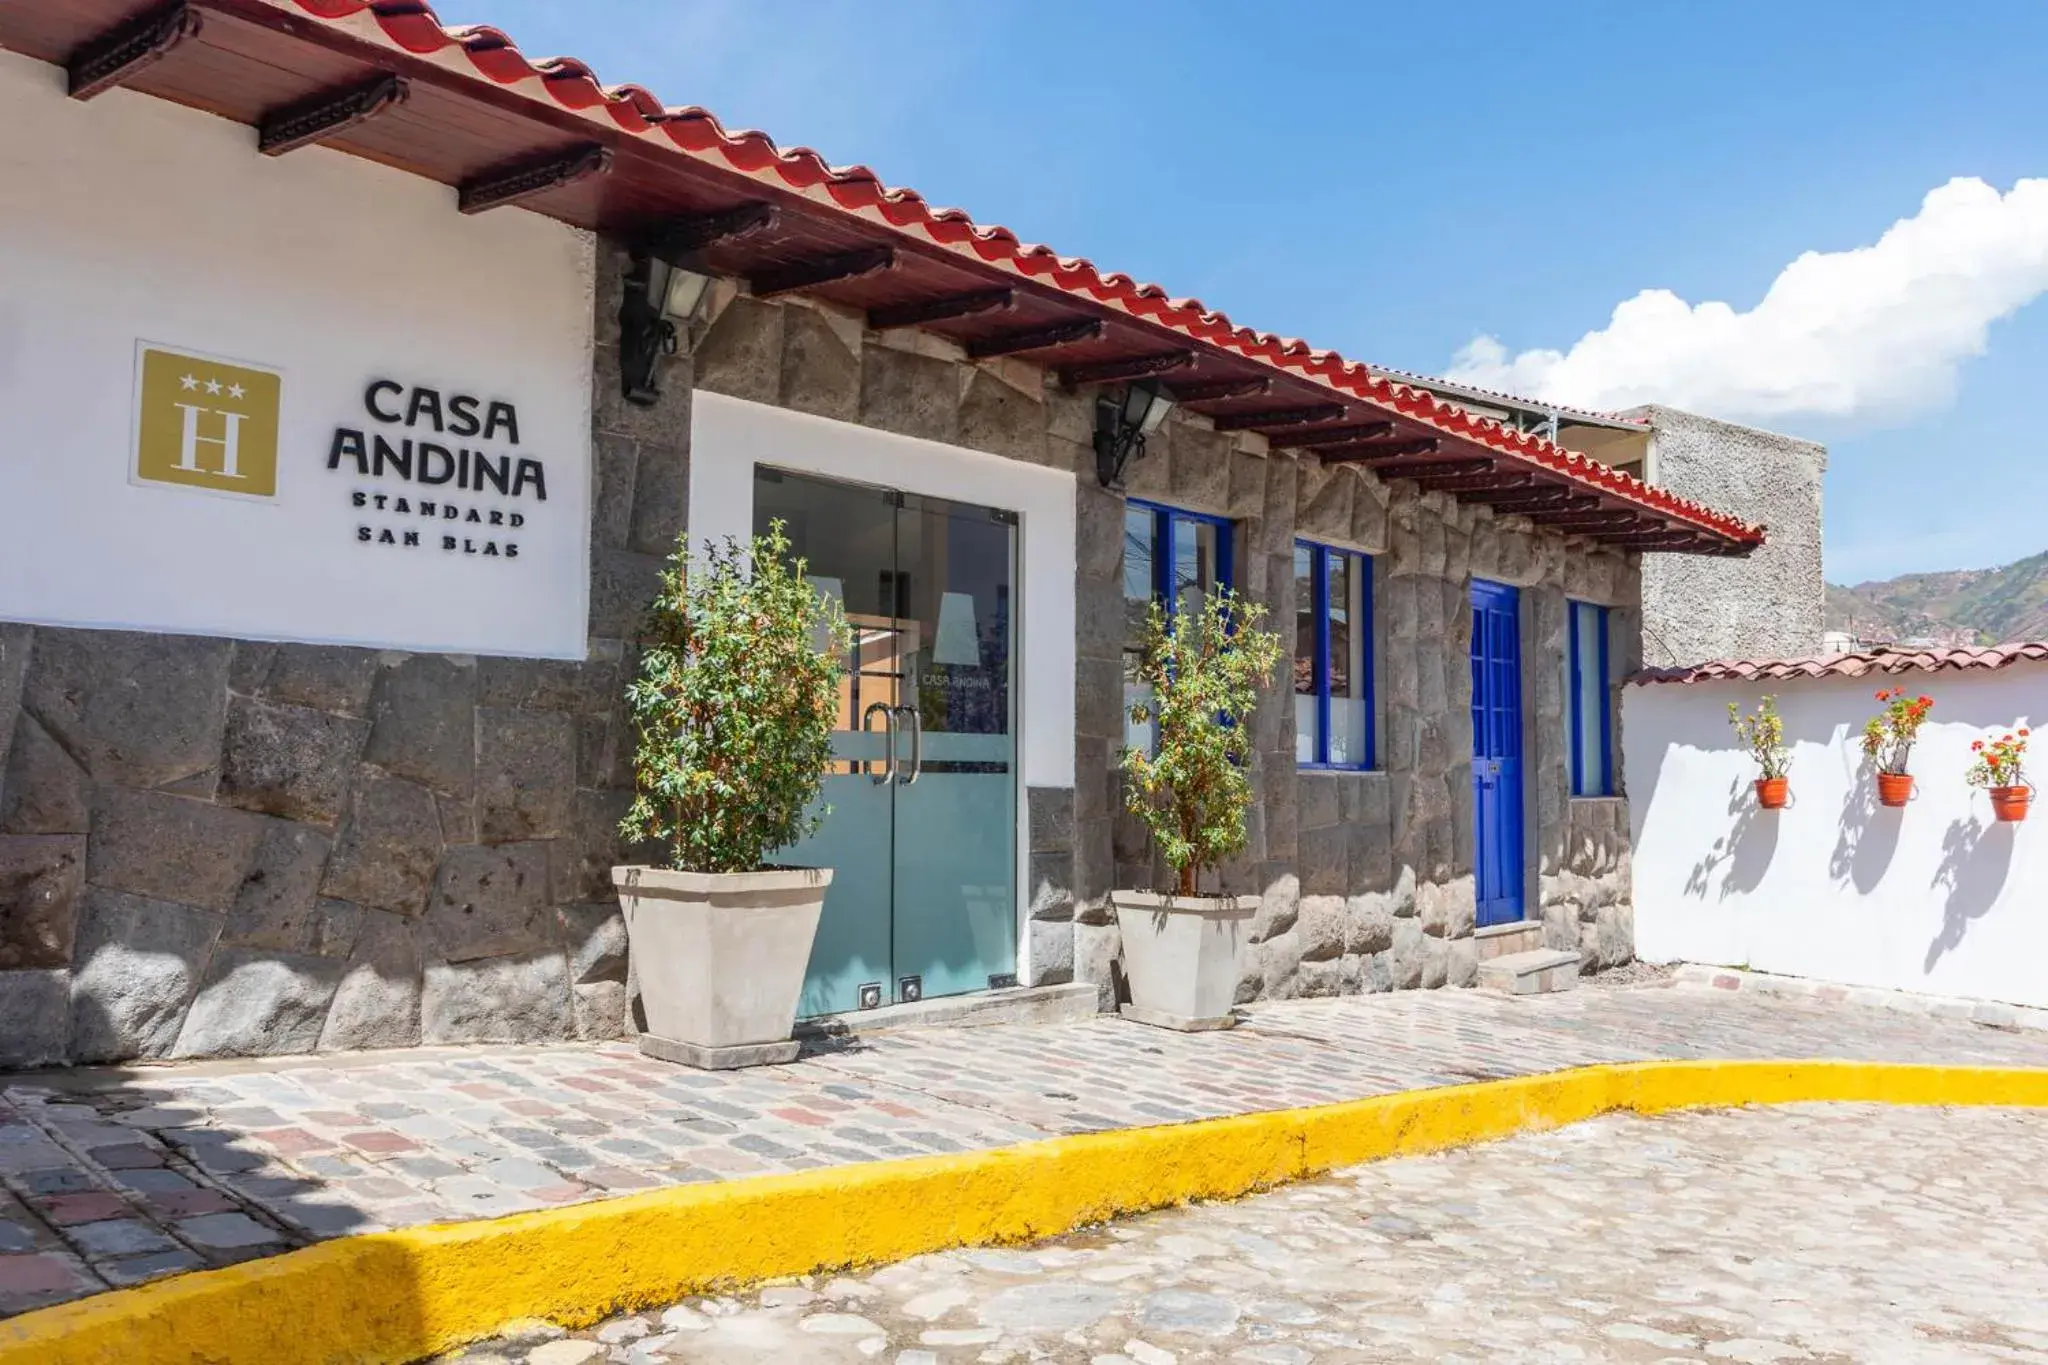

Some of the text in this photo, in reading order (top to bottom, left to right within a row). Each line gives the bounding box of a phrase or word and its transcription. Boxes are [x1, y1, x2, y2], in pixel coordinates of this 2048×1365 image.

[364, 379, 519, 444] CASA
[327, 427, 547, 501] ANDINA
[352, 491, 525, 527] STANDARD
[357, 526, 519, 558] SAN BLAS
[922, 674, 950, 687] CASA
